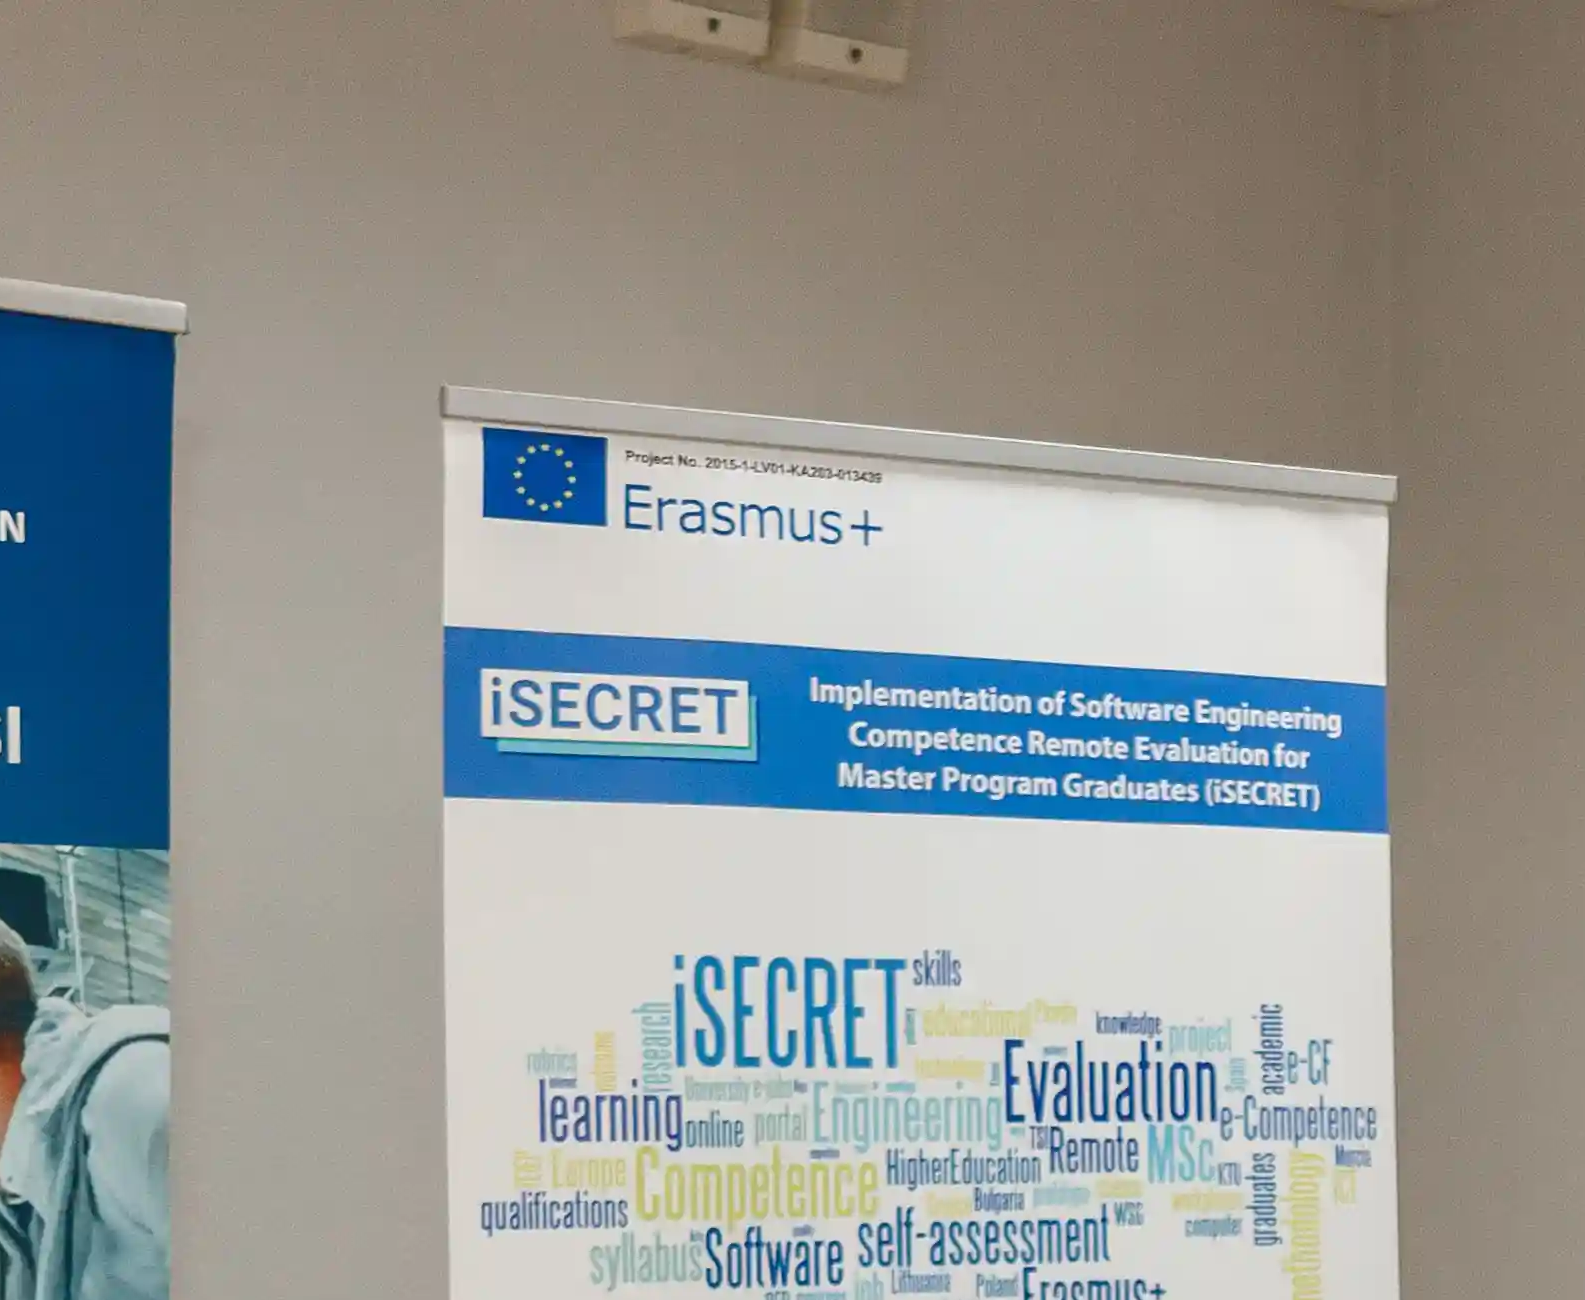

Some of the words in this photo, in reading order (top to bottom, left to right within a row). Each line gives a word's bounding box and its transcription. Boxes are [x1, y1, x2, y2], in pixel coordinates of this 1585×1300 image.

[624, 483, 883, 546] Erasmus+
[490, 678, 739, 737] iSECRET
[810, 676, 1031, 714] Implementation
[1037, 690, 1066, 716] of
[1070, 692, 1190, 722] Software
[1195, 699, 1342, 739] Engineering
[849, 721, 1023, 756] Competence
[1028, 730, 1129, 760] Remote
[1135, 736, 1269, 767] Evaluation
[1273, 742, 1310, 769] for
[838, 762, 936, 791] Master
[942, 766, 1057, 801] Program
[1063, 773, 1199, 803] Graduates
[1205, 778, 1320, 812] (iSECRET)
[913, 949, 962, 988] skills
[674, 954, 908, 1069] iSECRET
[1095, 1011, 1163, 1039] knowledge
[1169, 1017, 1232, 1056] project
[632, 1001, 672, 1093] research
[1252, 1003, 1284, 1096] academic
[1288, 1039, 1334, 1086] e-CF
[1004, 1039, 1218, 1124] Evaluation
[538, 1078, 683, 1152] learning
[685, 1109, 744, 1148] online
[754, 1104, 808, 1147] portal
[812, 1076, 1003, 1155] Engineering
[1219, 1095, 1377, 1147] e-Competence
[886, 1147, 1042, 1191] HigherEducation
[1049, 1126, 1139, 1175] Remote
[1146, 1123, 1215, 1183] MSc
[480, 1190, 629, 1237] qualifications
[635, 1145, 880, 1232] Competence
[1246, 1152, 1282, 1247] graduates
[588, 1229, 704, 1292] syllabus
[704, 1225, 844, 1289] Software
[857, 1203, 1111, 1268] self-assessment
